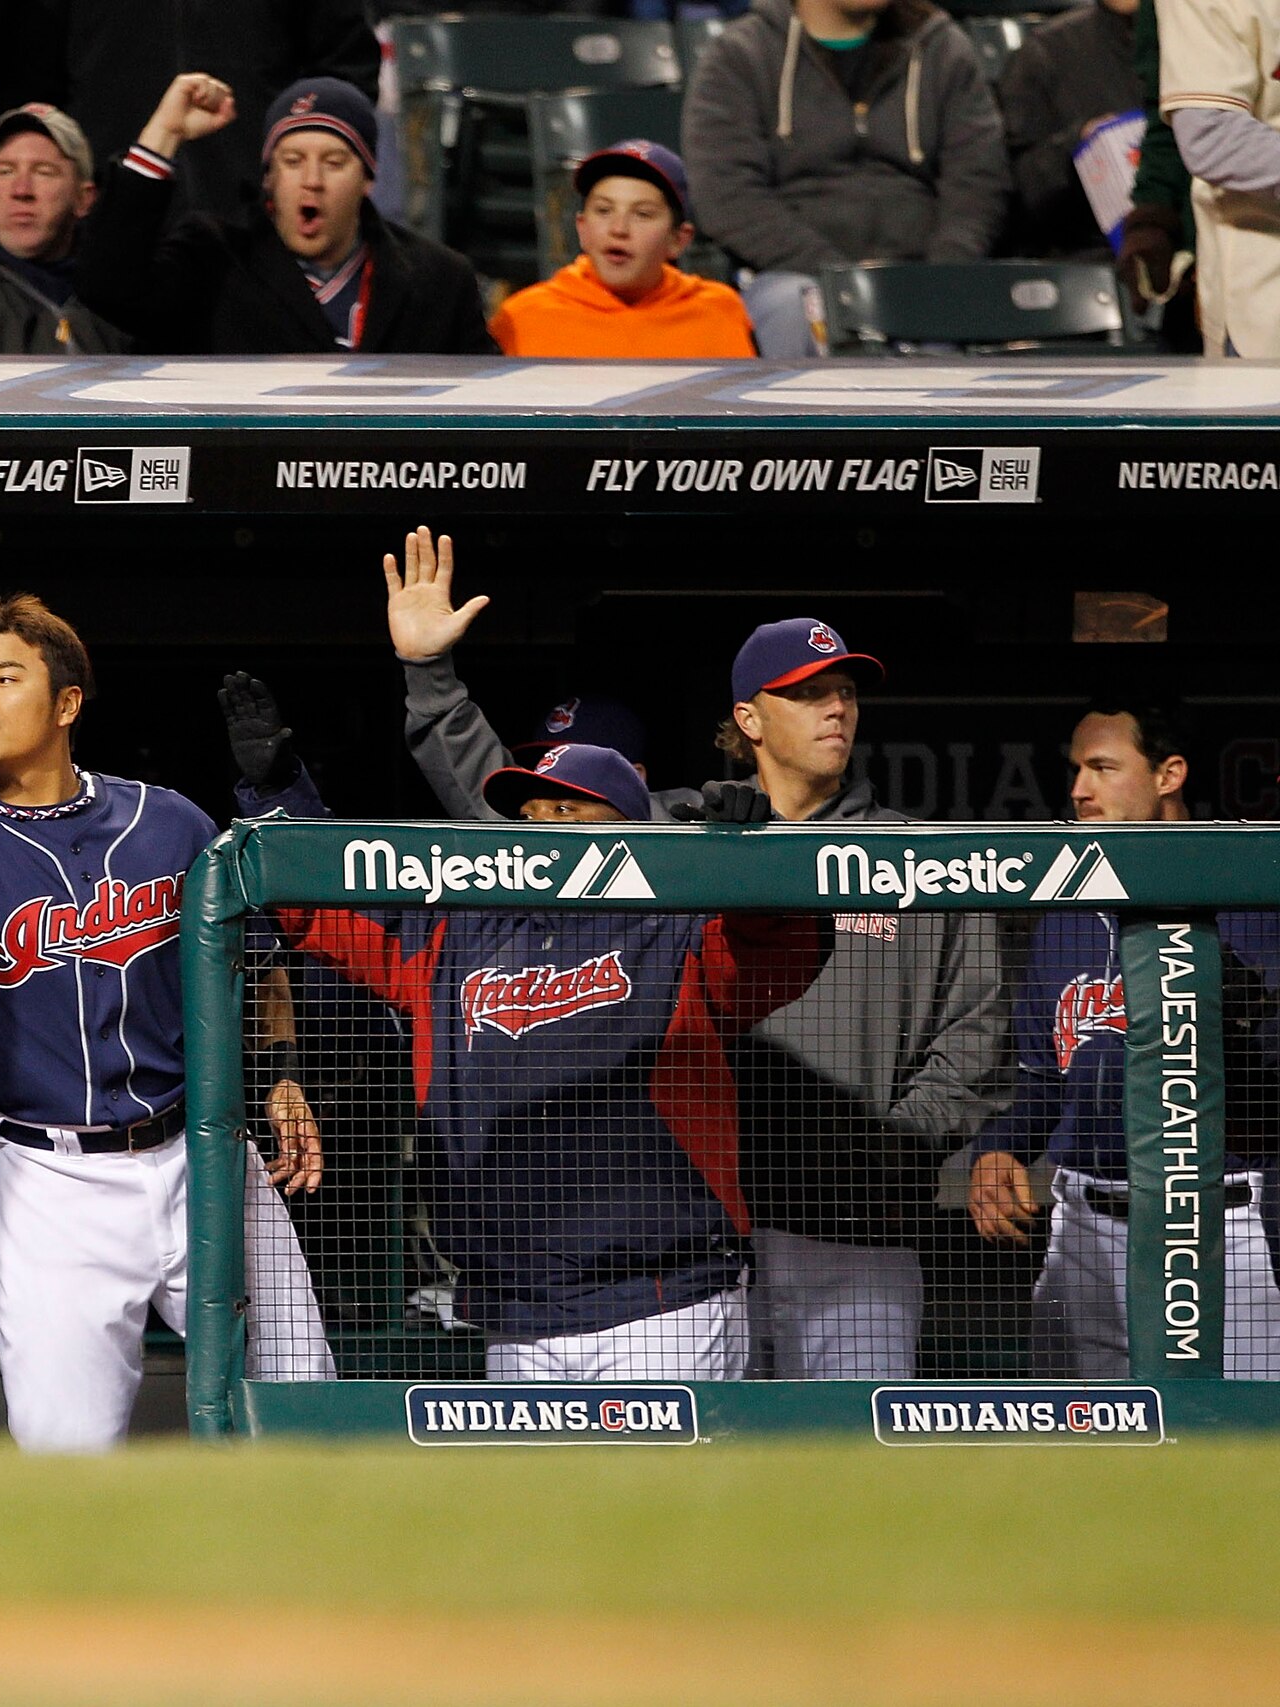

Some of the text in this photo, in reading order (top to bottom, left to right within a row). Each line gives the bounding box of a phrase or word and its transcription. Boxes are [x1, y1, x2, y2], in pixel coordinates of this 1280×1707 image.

[140, 459, 180, 474] NEW
[276, 461, 527, 489] NEWERACAP.COM
[586, 459, 920, 492] FLY YOUR OWN FLAG
[990, 458, 1030, 474] NEW
[1118, 462, 1280, 490] NEWERACA
[139, 475, 179, 491] ERA
[989, 475, 1029, 491] ERA
[344, 839, 554, 904] Majestic
[817, 844, 1027, 909] Majestic
[833, 913, 898, 942] DIANS
[460, 950, 632, 1052] Indians
[1157, 923, 1200, 1360] MAJESTICATHLETIC.COM
[424, 1400, 682, 1432] INDIANS.COM
[890, 1401, 1148, 1433] INDIANS.COM
